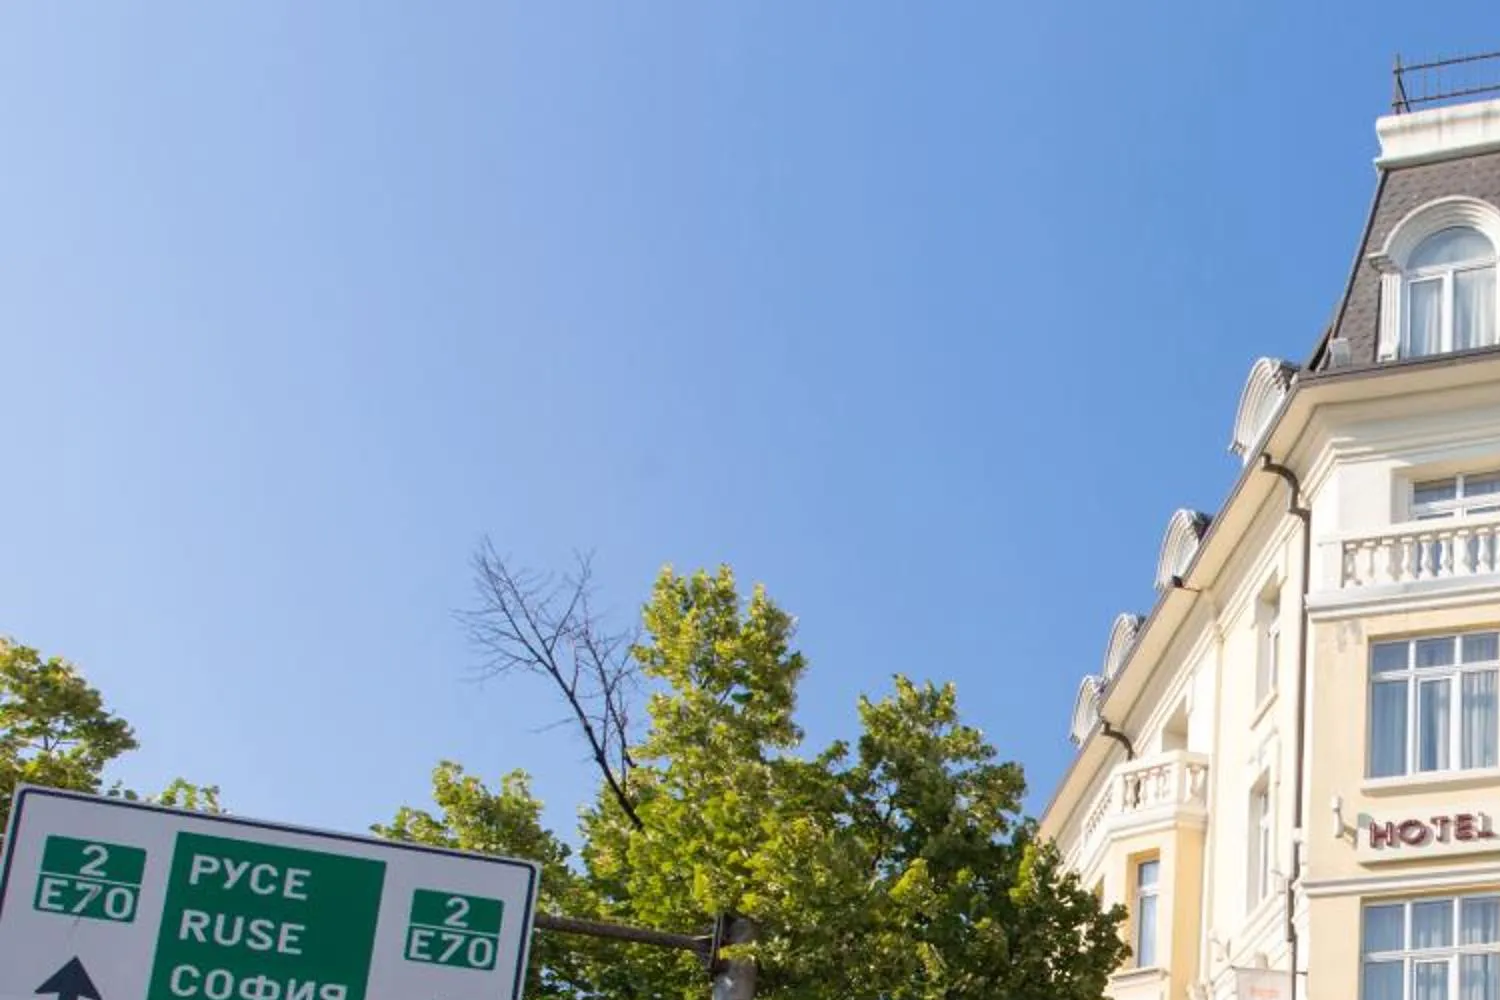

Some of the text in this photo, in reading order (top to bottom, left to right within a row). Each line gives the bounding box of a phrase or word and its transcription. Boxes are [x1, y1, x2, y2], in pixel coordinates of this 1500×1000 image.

[1370, 812, 1497, 849] HOTEL
[79, 844, 109, 877] 2
[189, 853, 312, 900] РУСЕ
[39, 877, 134, 919] E70
[444, 897, 471, 928] 2
[179, 909, 306, 955] RUSE
[409, 928, 493, 968] E70
